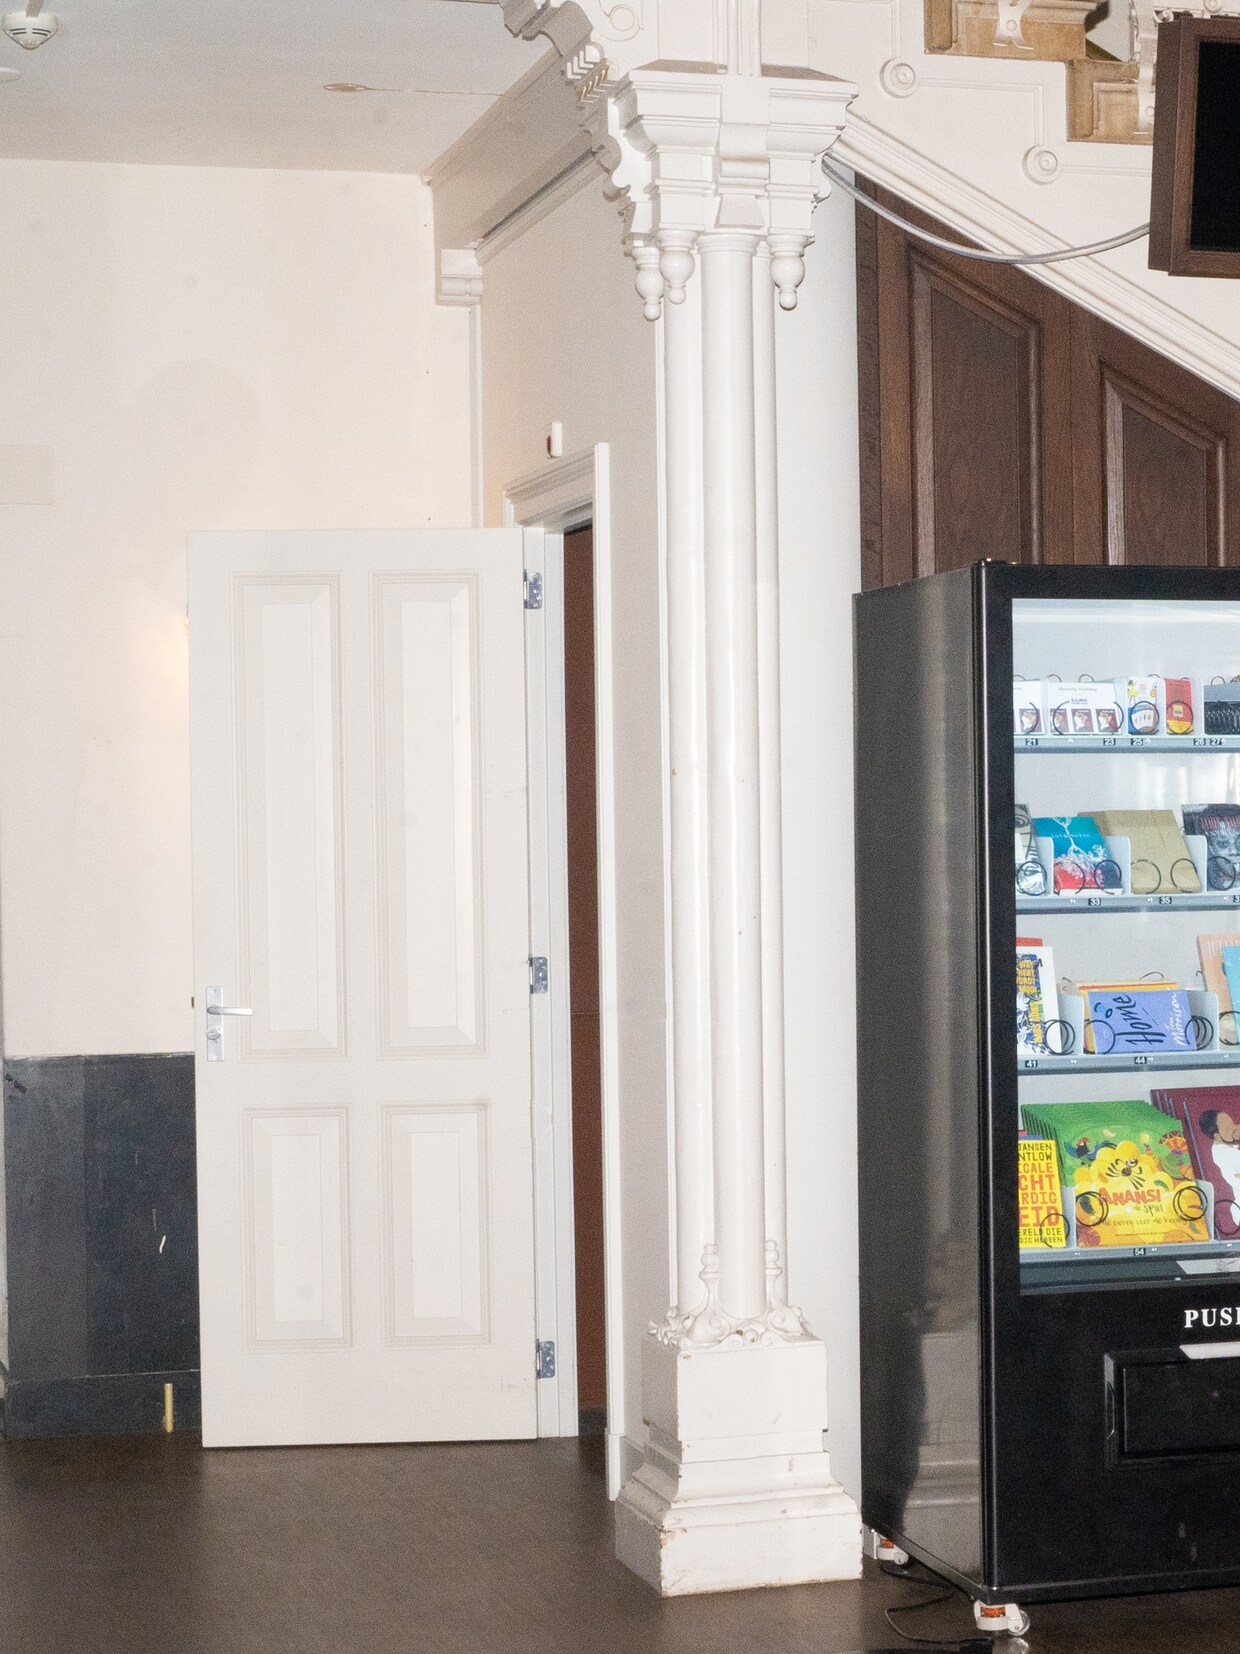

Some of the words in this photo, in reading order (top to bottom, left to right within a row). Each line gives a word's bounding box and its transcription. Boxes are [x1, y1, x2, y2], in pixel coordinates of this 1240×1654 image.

[1026, 738, 1036, 746] 21
[1104, 738, 1115, 746] 23
[1211, 738, 1221, 746] 27
[1159, 896, 1171, 904] 35
[1099, 1187, 1162, 1206] ANANSI
[1046, 1227, 1061, 1236] DIE
[1134, 1248, 1145, 1256] 54
